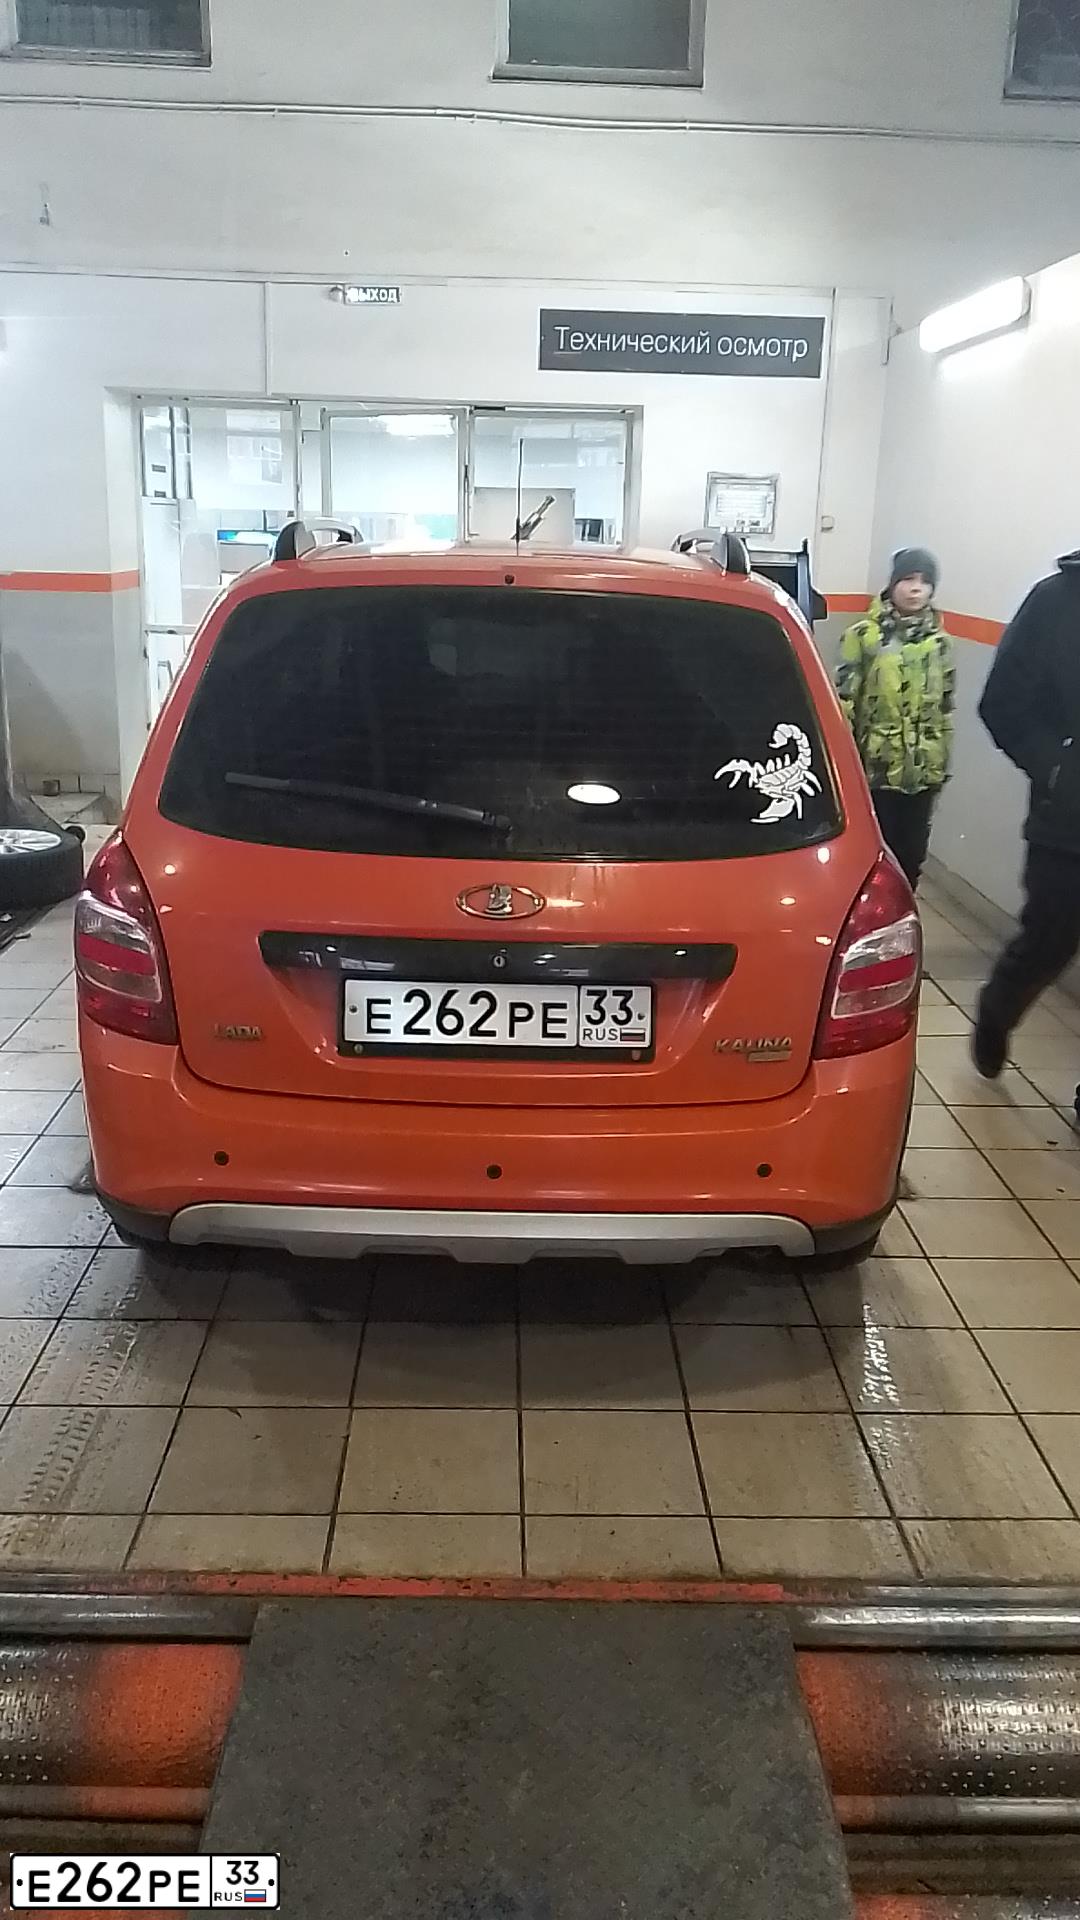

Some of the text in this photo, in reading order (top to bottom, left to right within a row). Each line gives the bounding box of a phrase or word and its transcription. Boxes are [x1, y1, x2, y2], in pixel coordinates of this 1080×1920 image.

[554, 325, 809, 363] Технический осмотр
[585, 989, 634, 1026] 33
[583, 1028, 618, 1041] RUS
